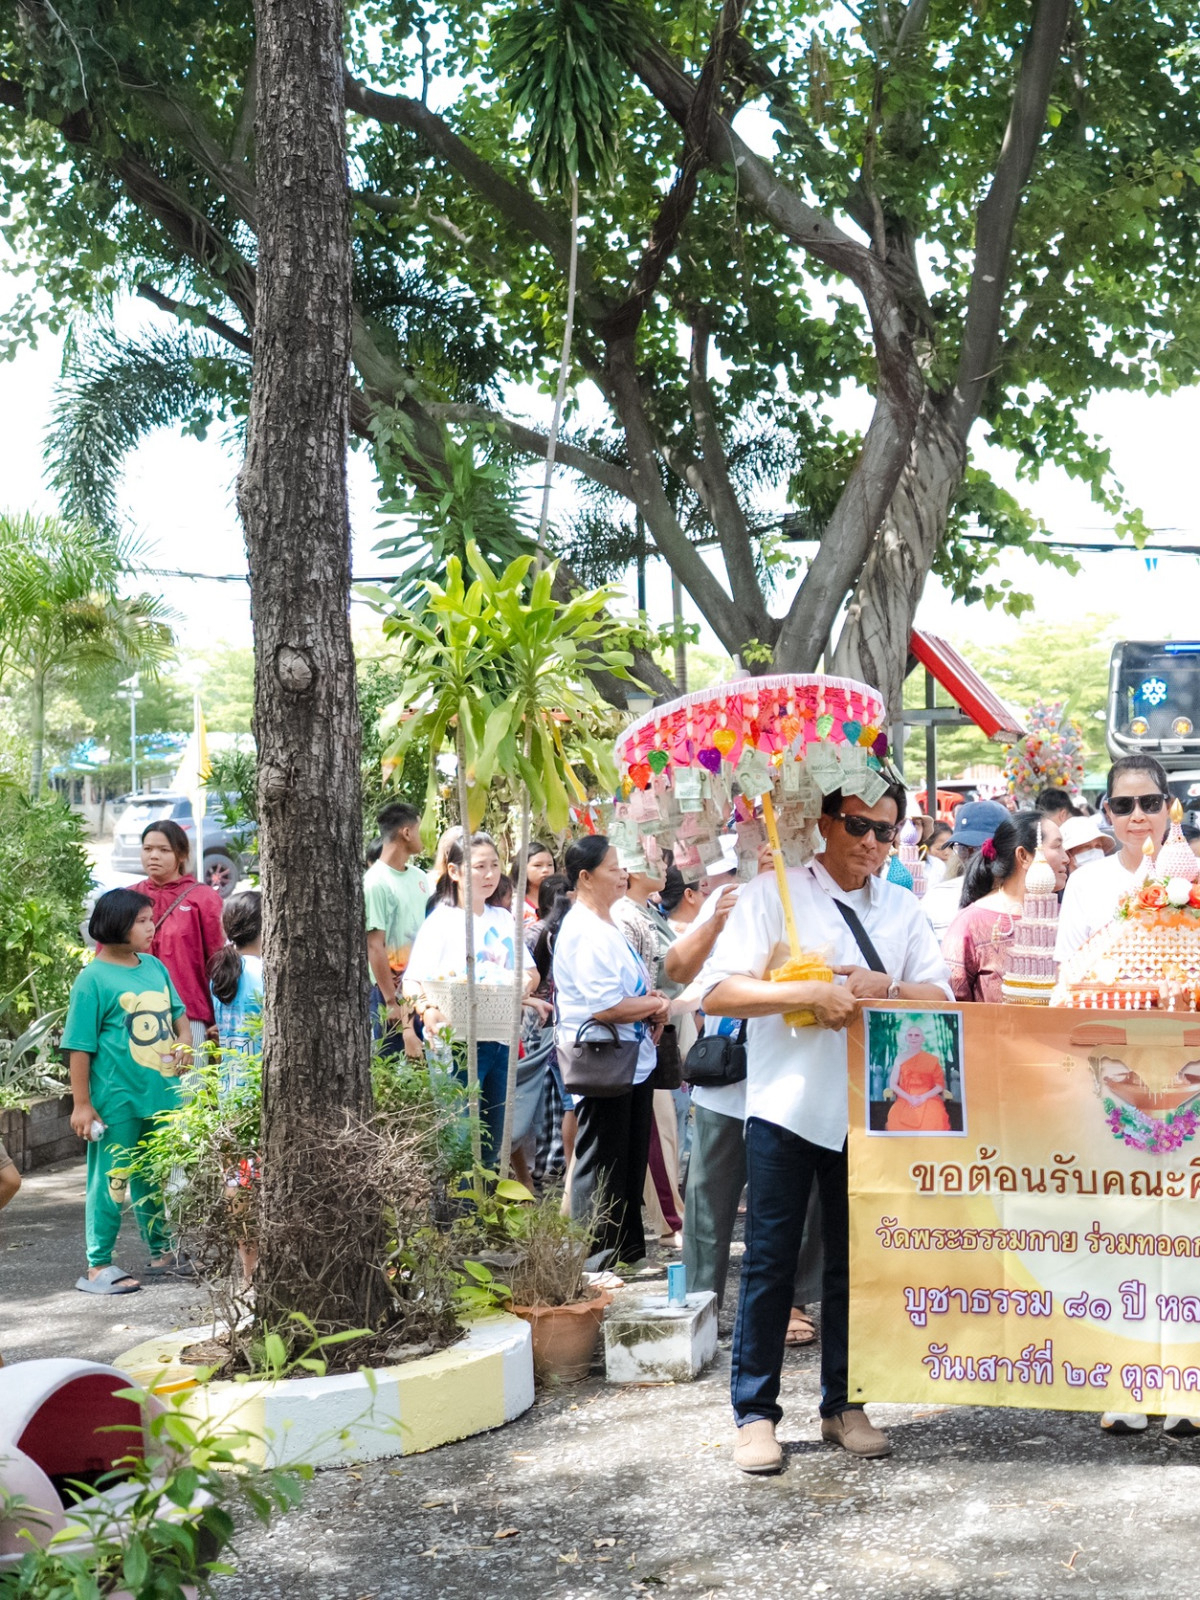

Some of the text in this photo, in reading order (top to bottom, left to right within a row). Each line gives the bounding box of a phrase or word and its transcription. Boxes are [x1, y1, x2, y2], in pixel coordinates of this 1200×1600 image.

[876, 1218, 1078, 1254] วัดพระธรรมกาย
[903, 1283, 1053, 1327] บูชาธรรม
[1063, 1296, 1111, 1321] ๘๑
[1119, 1279, 1147, 1321] ปี
[922, 1342, 1054, 1387] วันเสาร์ที่
[1062, 1361, 1110, 1389] ๒๕
